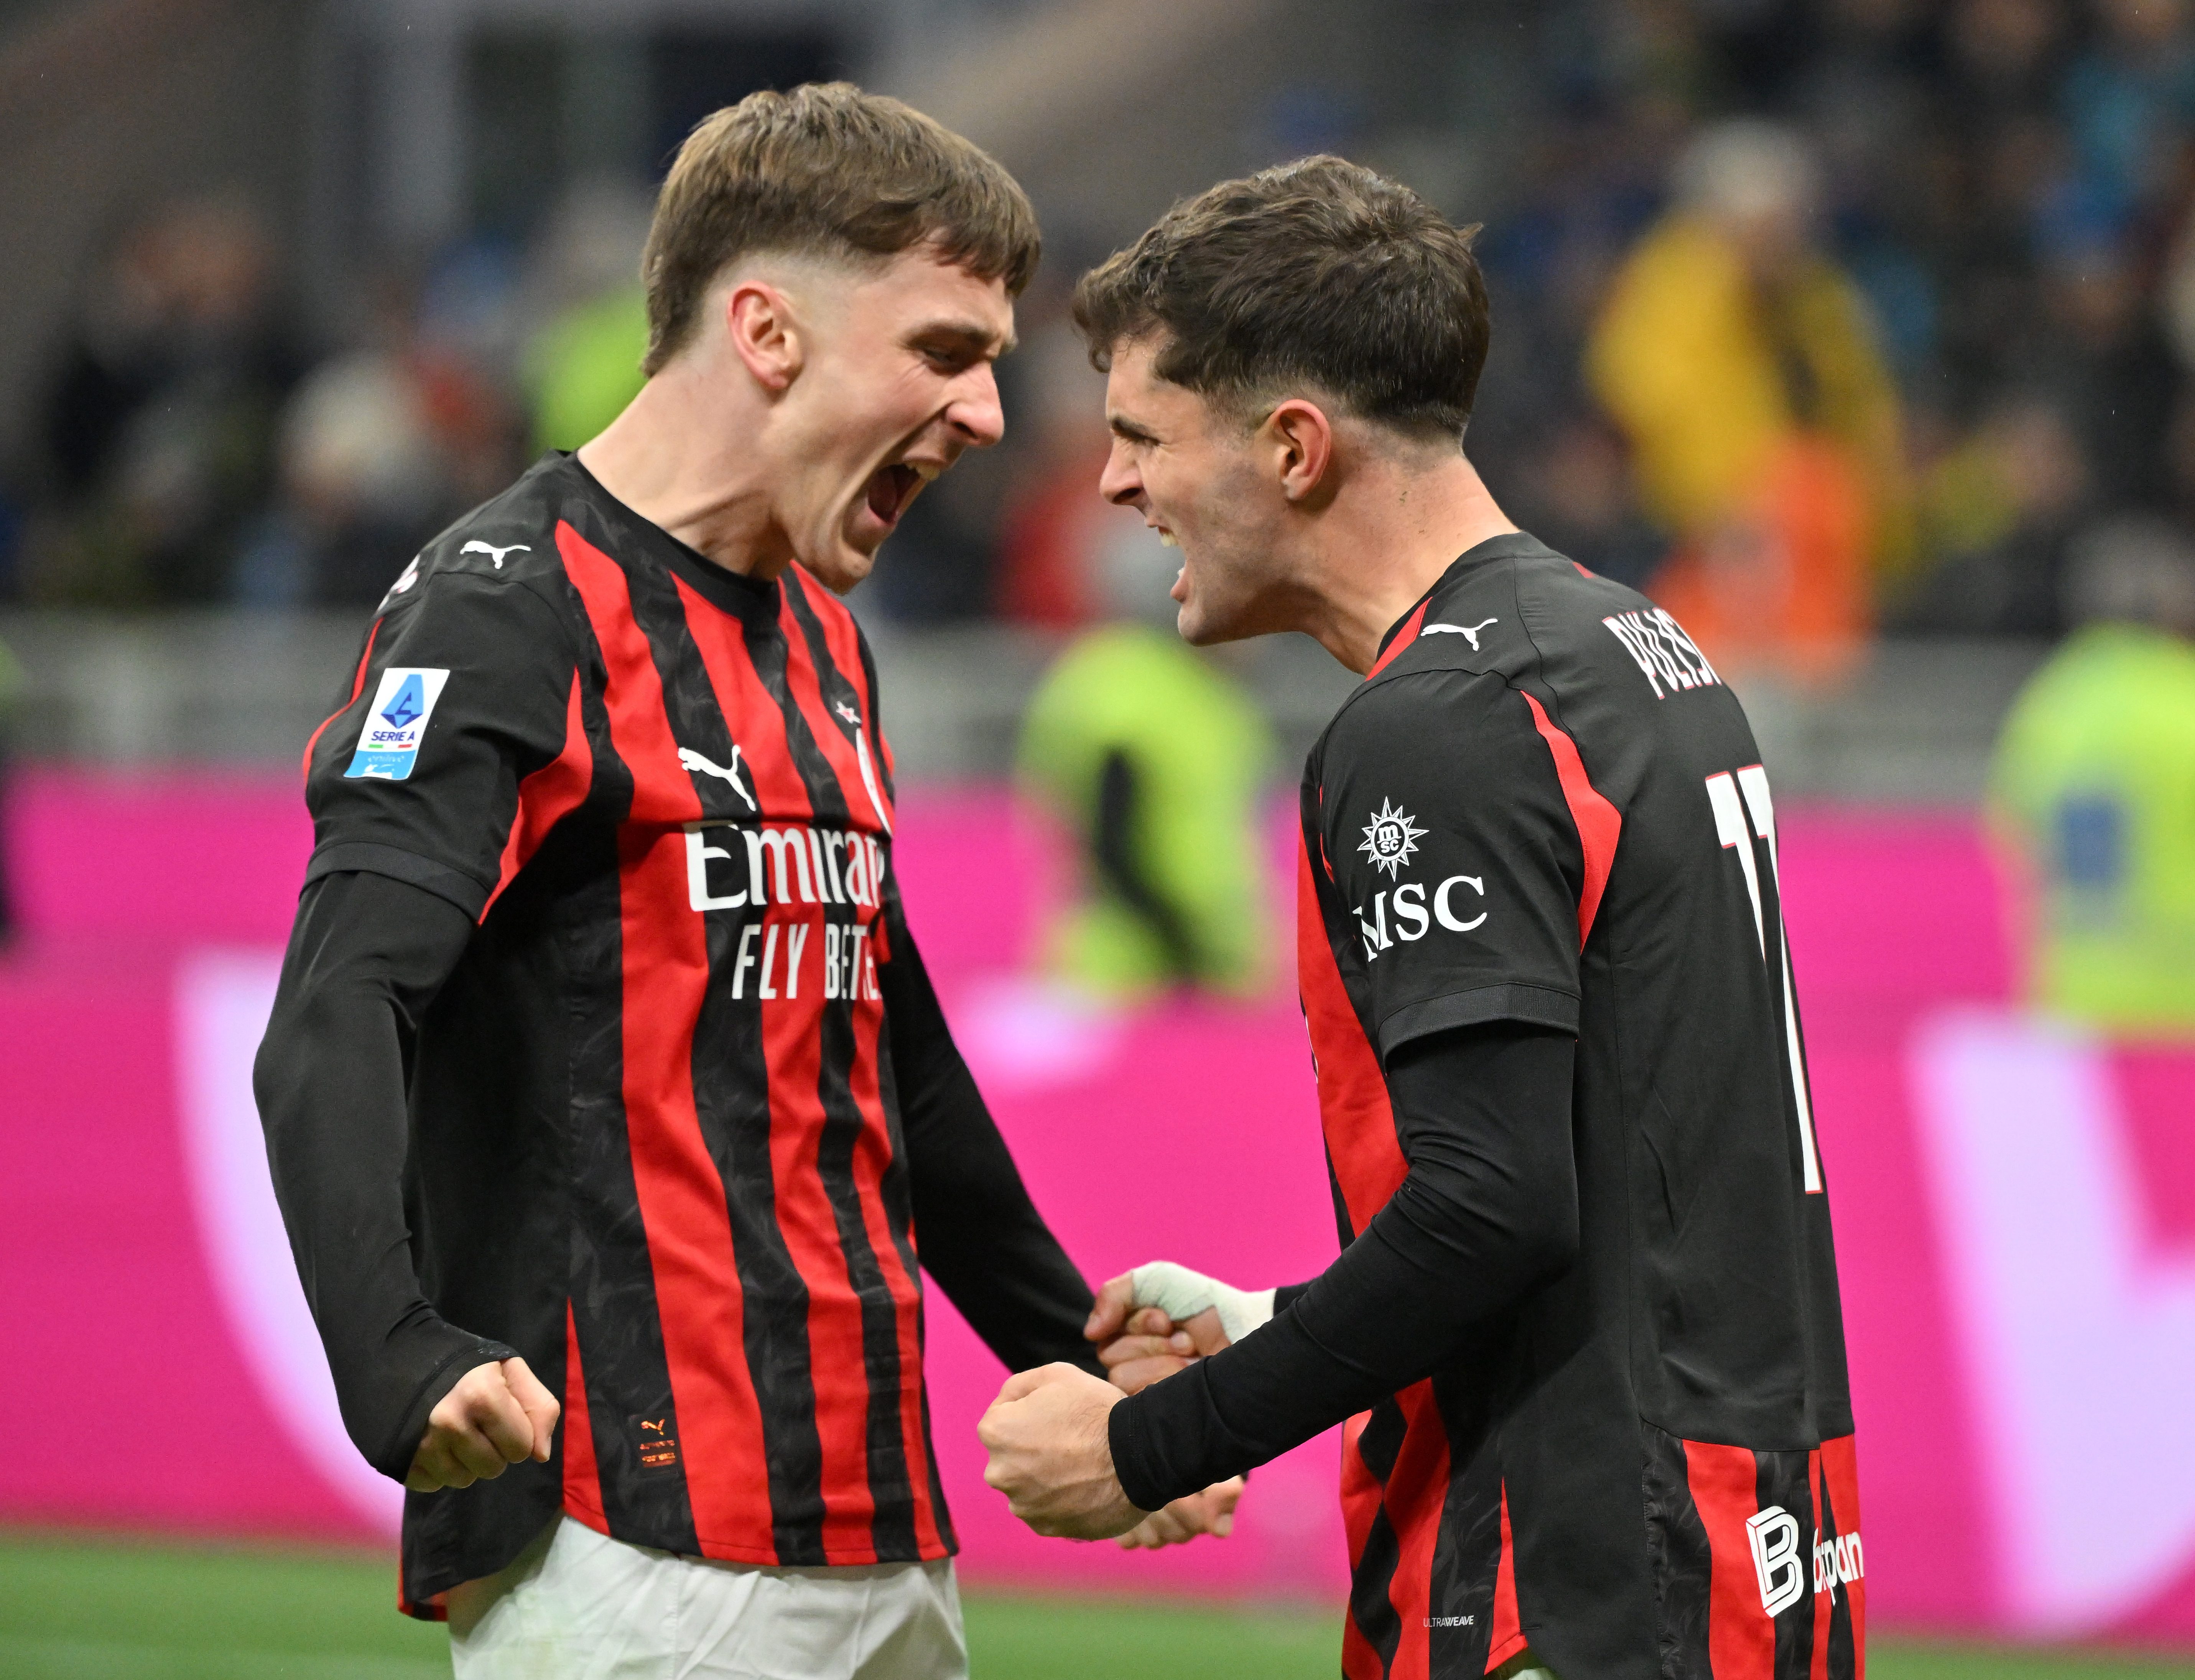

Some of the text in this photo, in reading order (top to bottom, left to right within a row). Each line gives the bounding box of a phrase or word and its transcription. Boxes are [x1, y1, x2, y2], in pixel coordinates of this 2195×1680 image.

[371, 731, 415, 741] SERIE A
[1352, 875, 1487, 962] MSC
[732, 923, 809, 1000] FLY
[1423, 1615, 1474, 1627] ULTRAWEAVE
